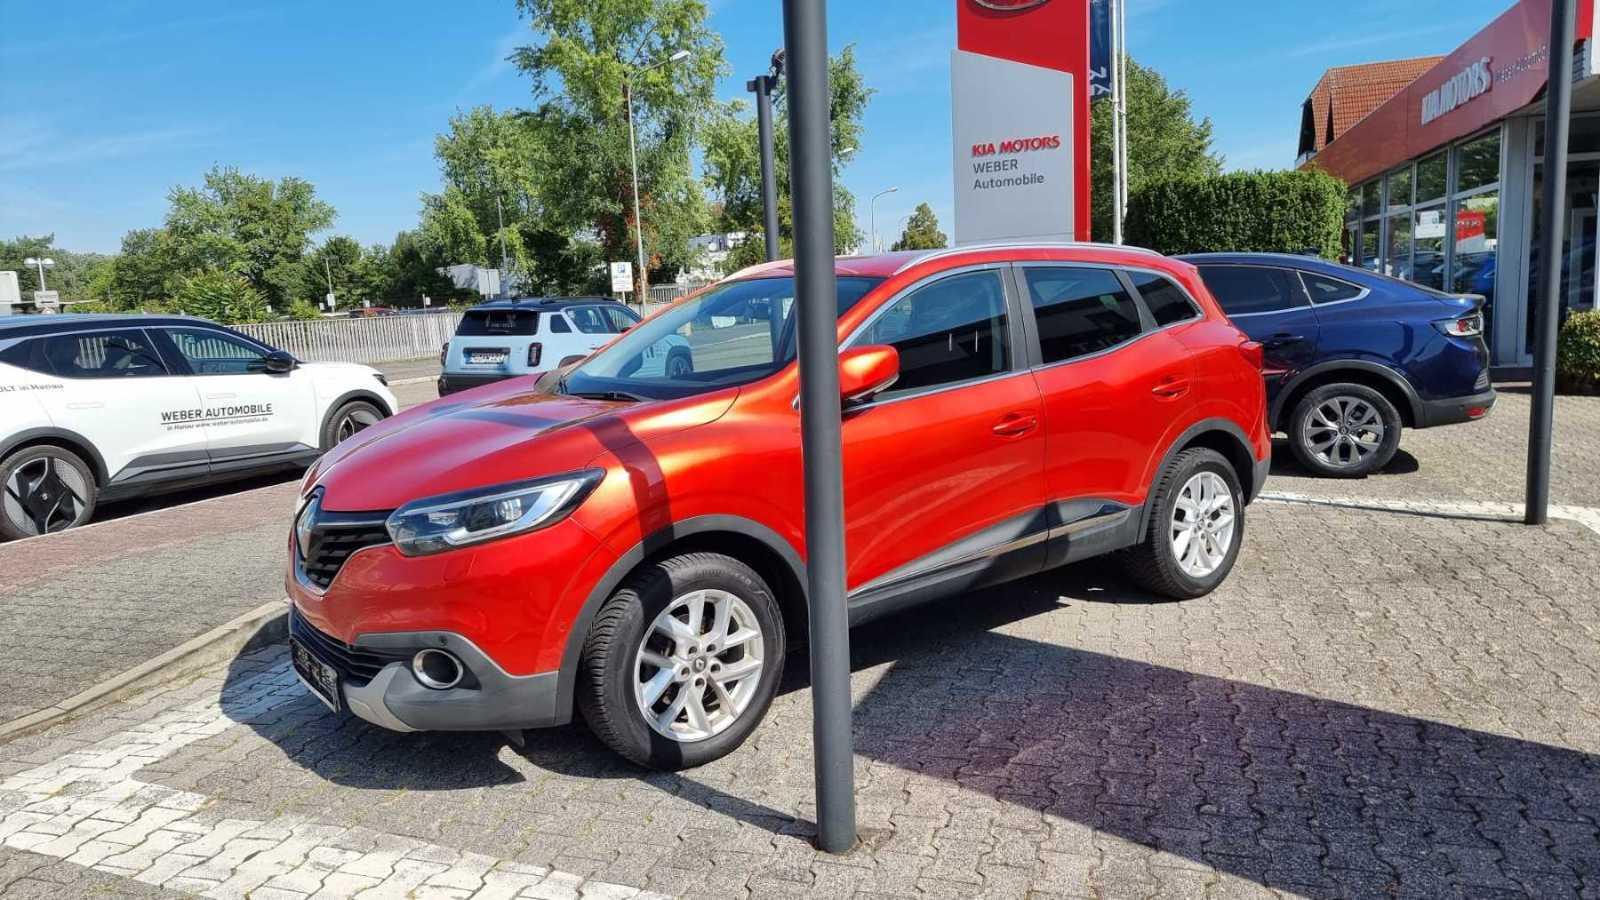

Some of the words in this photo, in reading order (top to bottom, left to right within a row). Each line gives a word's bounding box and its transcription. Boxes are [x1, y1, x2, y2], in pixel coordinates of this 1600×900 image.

[1440, 57, 1490, 116] MOTORS
[972, 143, 996, 157] KIA
[999, 136, 1060, 153] MOTORS
[973, 159, 1018, 174] WEBER
[973, 173, 1045, 190] Automobile
[161, 409, 202, 421] WEBER
[205, 403, 272, 417] AUTOMOBILE
